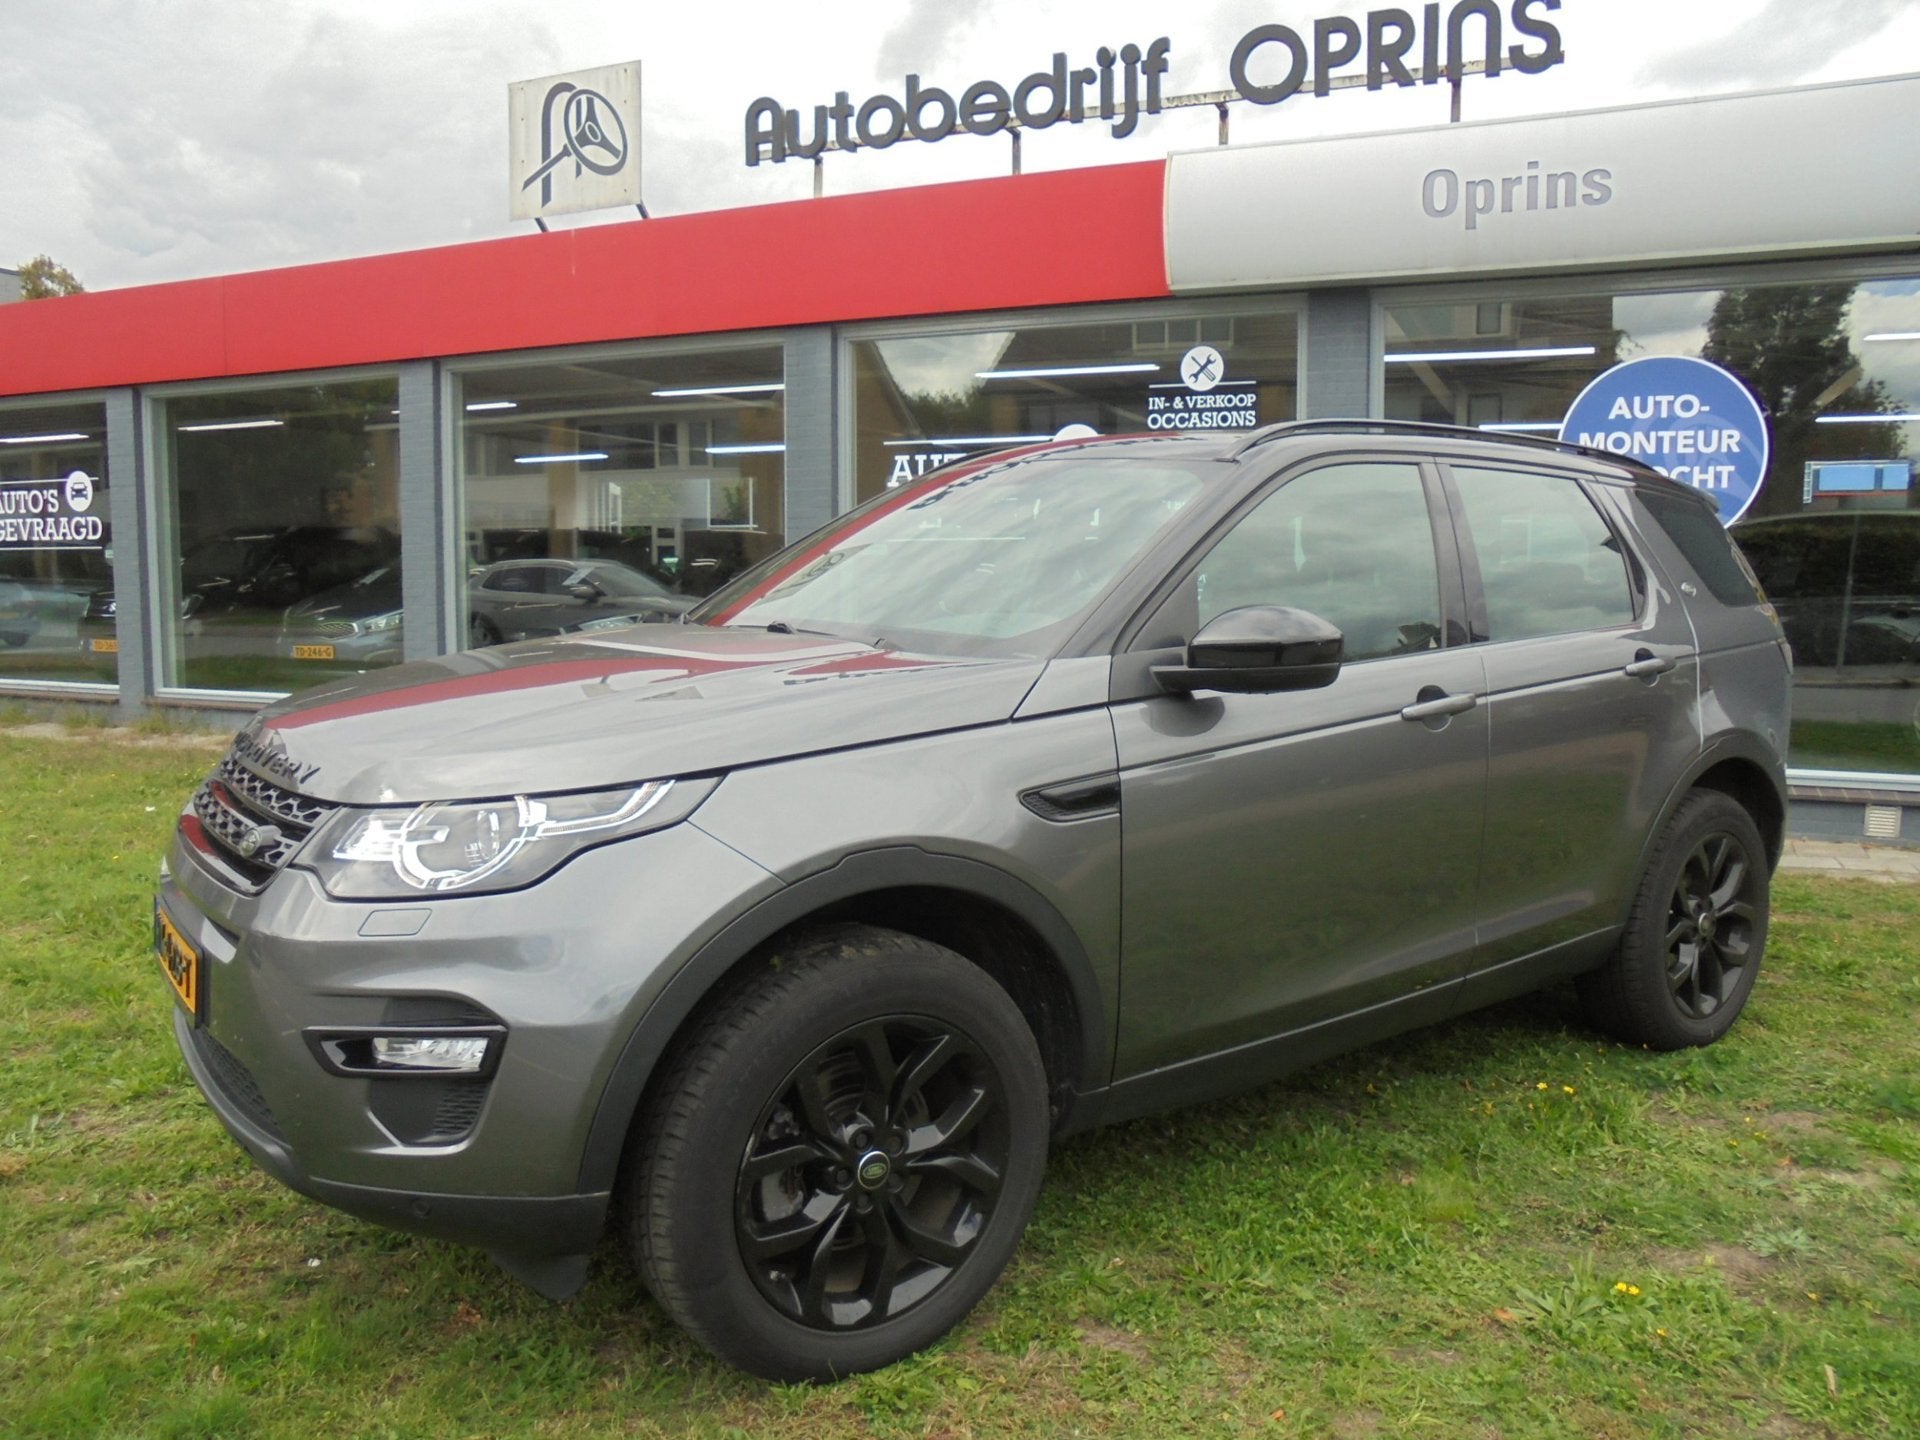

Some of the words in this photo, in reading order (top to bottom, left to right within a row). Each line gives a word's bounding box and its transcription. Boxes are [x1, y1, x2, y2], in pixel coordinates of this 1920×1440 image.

[745, 37, 1171, 166] Autobedrijf
[1229, 0, 1562, 105] OPRINS
[1422, 160, 1612, 230] Oprins
[1173, 396, 1184, 409] &
[1186, 393, 1257, 409] VERKOOP
[1608, 394, 1710, 419] AUTO-
[1147, 410, 1256, 429] OCCASIONS
[1579, 429, 1741, 455] MONTEUR
